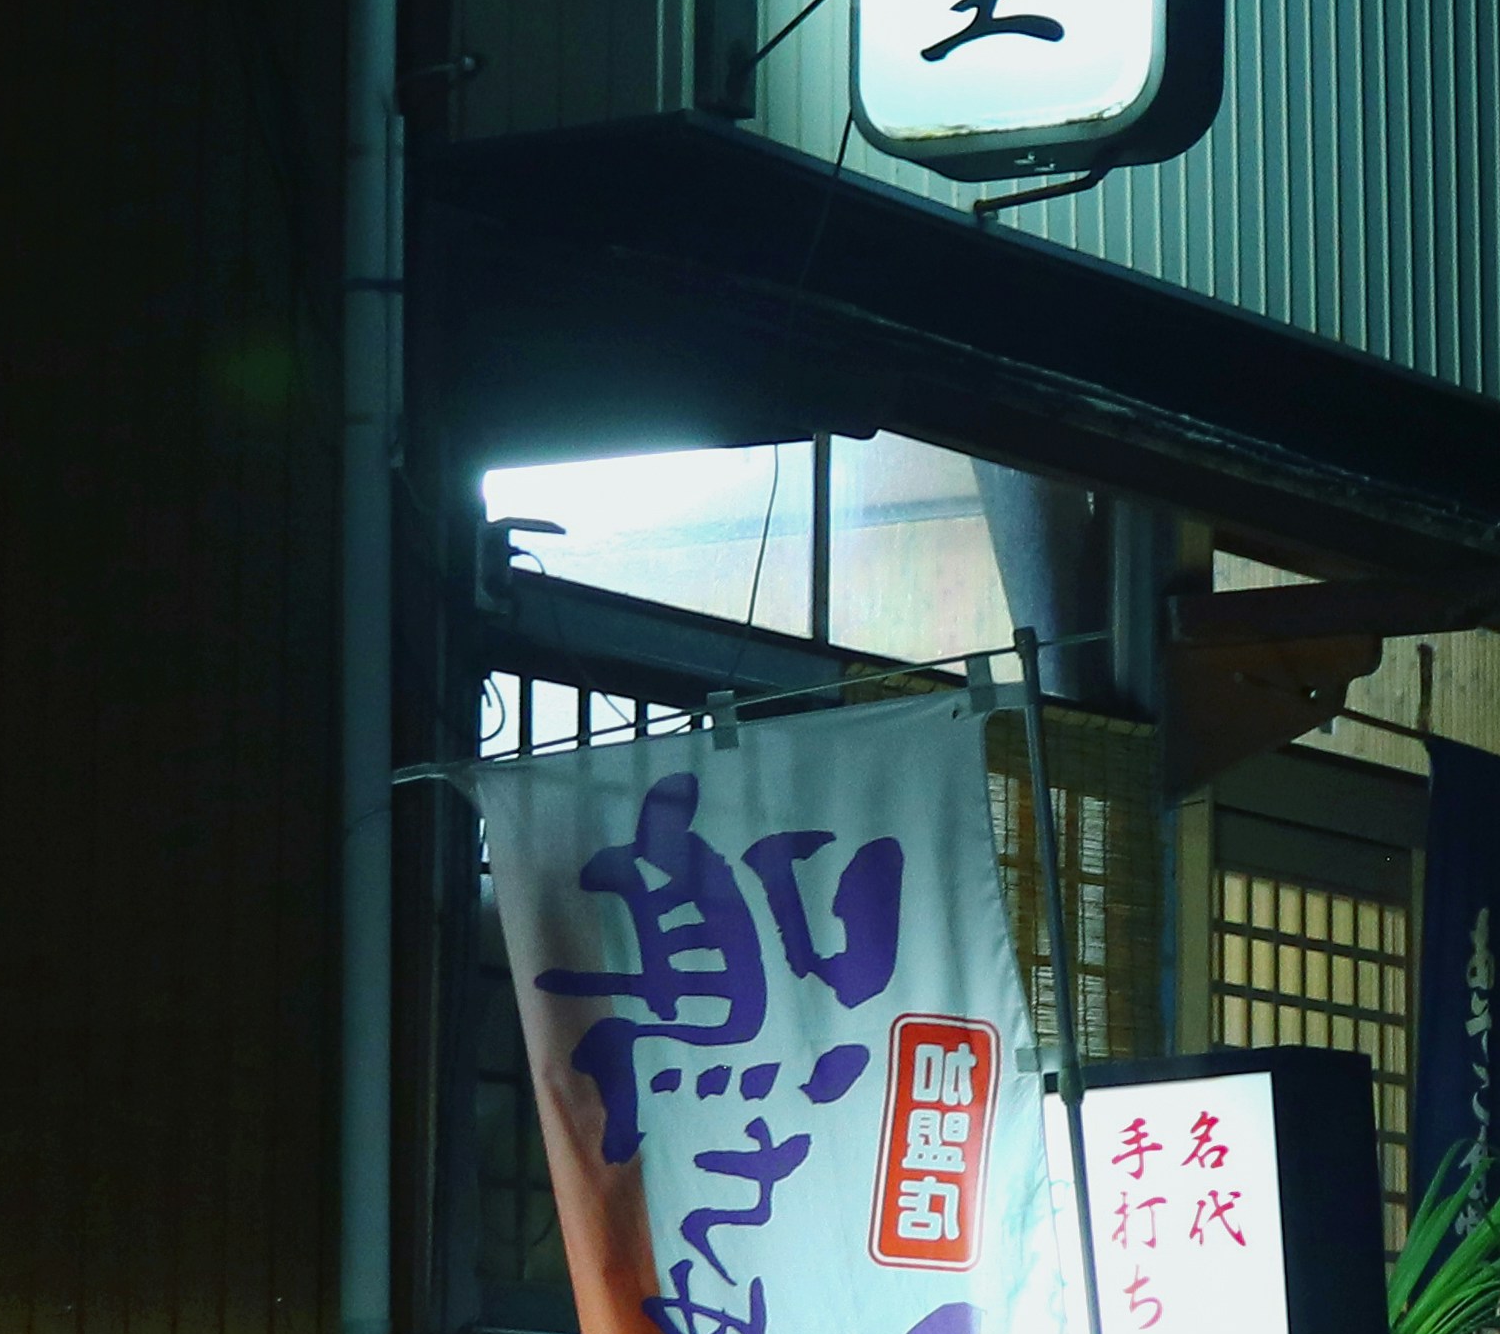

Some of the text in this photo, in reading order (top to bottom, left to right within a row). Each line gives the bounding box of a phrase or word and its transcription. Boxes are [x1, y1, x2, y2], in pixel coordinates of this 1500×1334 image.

[1111, 1115, 1169, 1330] 手打ち
[1181, 1108, 1246, 1248] 名代
